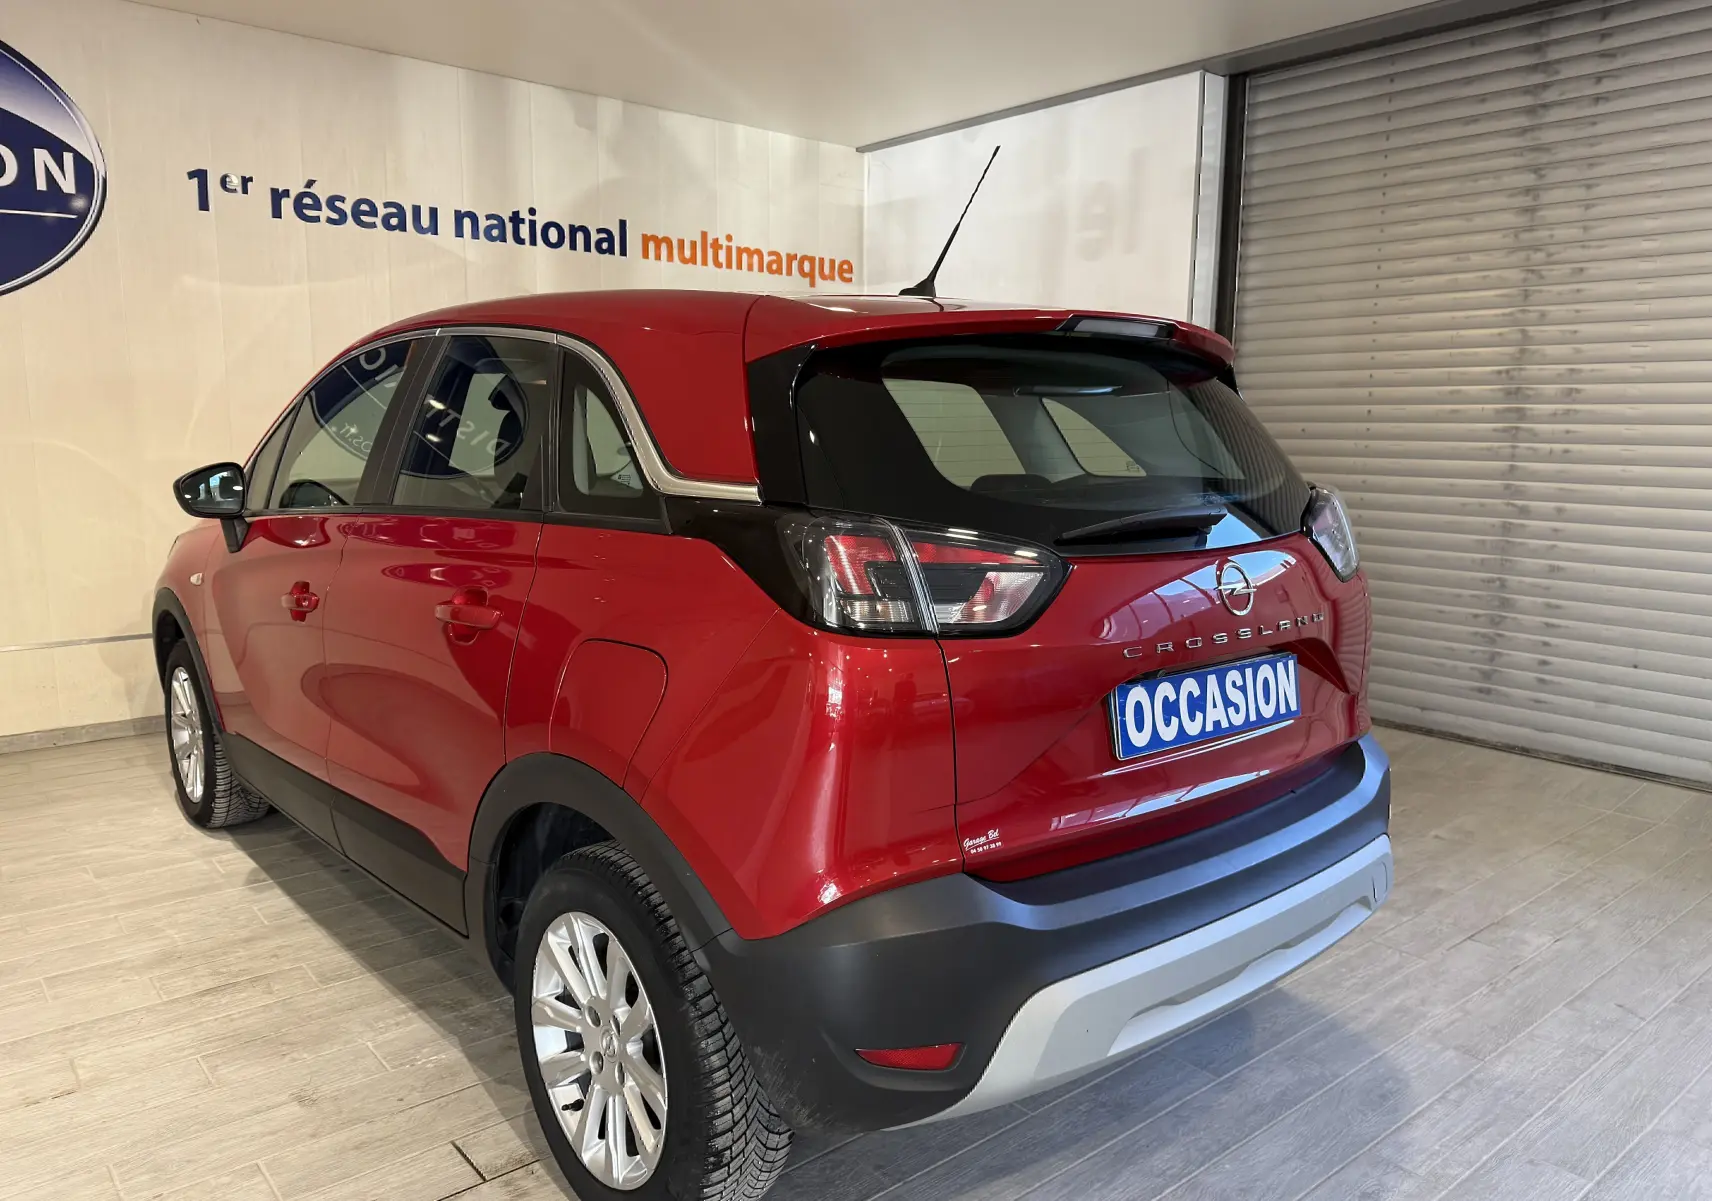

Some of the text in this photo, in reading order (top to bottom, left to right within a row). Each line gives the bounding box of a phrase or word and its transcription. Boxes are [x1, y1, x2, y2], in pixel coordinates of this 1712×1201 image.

[187, 168, 854, 287] 1er réseau national multimarque
[1123, 612, 1324, 658] CROSSLAND
[1125, 660, 1298, 747] OCCASION
[963, 836, 987, 849] Garage
